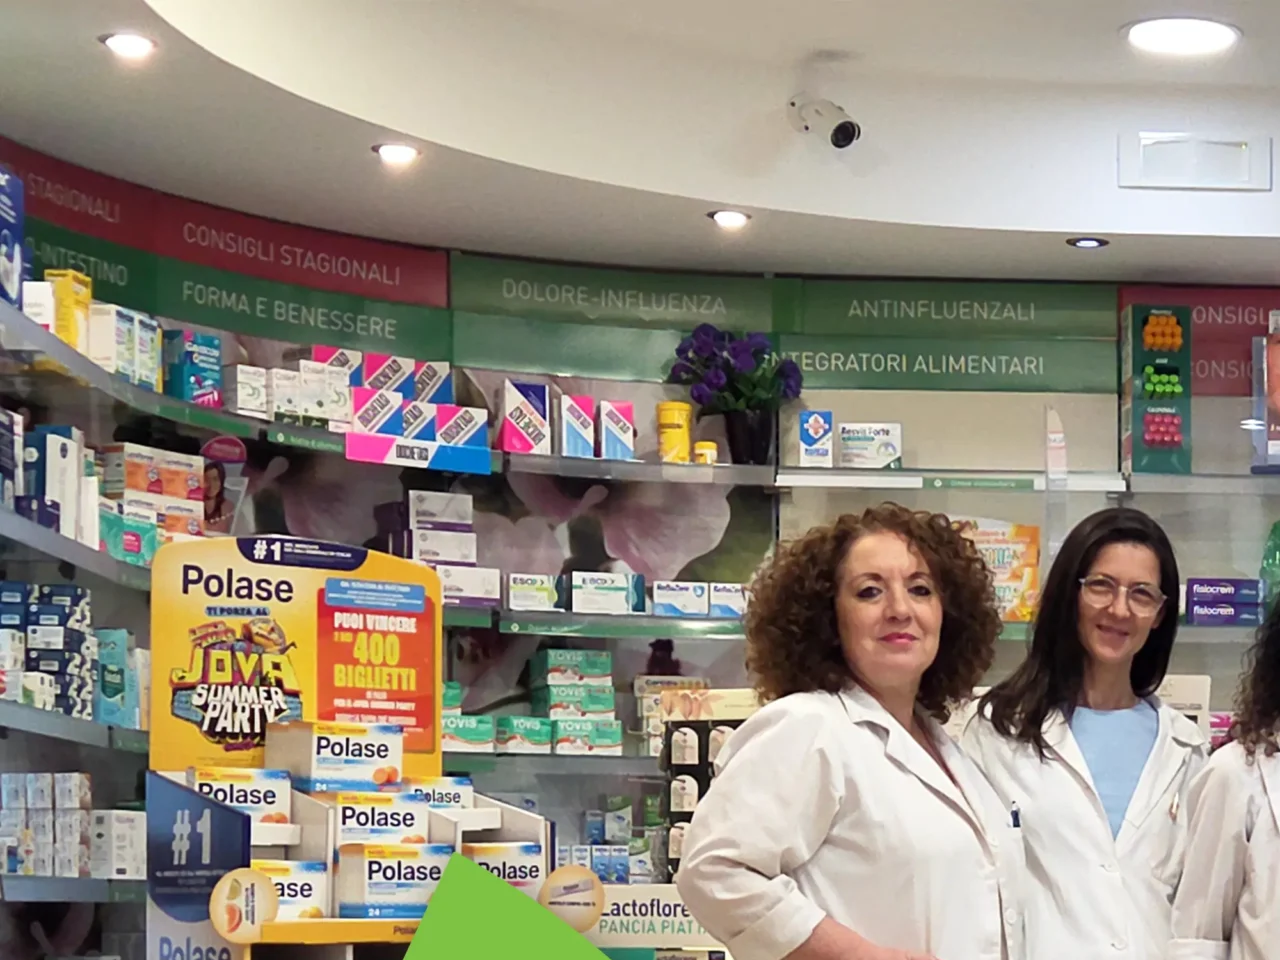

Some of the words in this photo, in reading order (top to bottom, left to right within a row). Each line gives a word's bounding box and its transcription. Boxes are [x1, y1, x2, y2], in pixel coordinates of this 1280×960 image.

[183, 221, 274, 263] CONSIGLI
[280, 245, 400, 287] STAGIONALI
[183, 280, 251, 314] FORMA
[256, 296, 268, 319] E
[274, 301, 397, 340] BENESSERE
[849, 299, 1036, 321] ANTINFLUENZALI
[1192, 306, 1269, 325] ONSIGL
[913, 355, 1044, 376] ALIMENTARI
[182, 564, 293, 603] Polase
[334, 612, 363, 630] PUOI
[366, 613, 417, 633] VINCERE
[353, 631, 400, 666] 400
[550, 651, 583, 662] YOVIS
[170, 647, 300, 692] JOVA
[333, 664, 417, 691] BIGLIETTI
[191, 683, 288, 711] SUMMER
[552, 687, 586, 697] YOVIS
[513, 718, 541, 730] YOVIS
[559, 721, 593, 731] YOVIS
[316, 736, 389, 758] Polase
[198, 782, 276, 806] Polase
[342, 806, 415, 828] Polase
[171, 808, 212, 865] #1
[368, 860, 441, 881] Polase
[276, 881, 313, 898] ase
[599, 919, 656, 934] PANCIA
